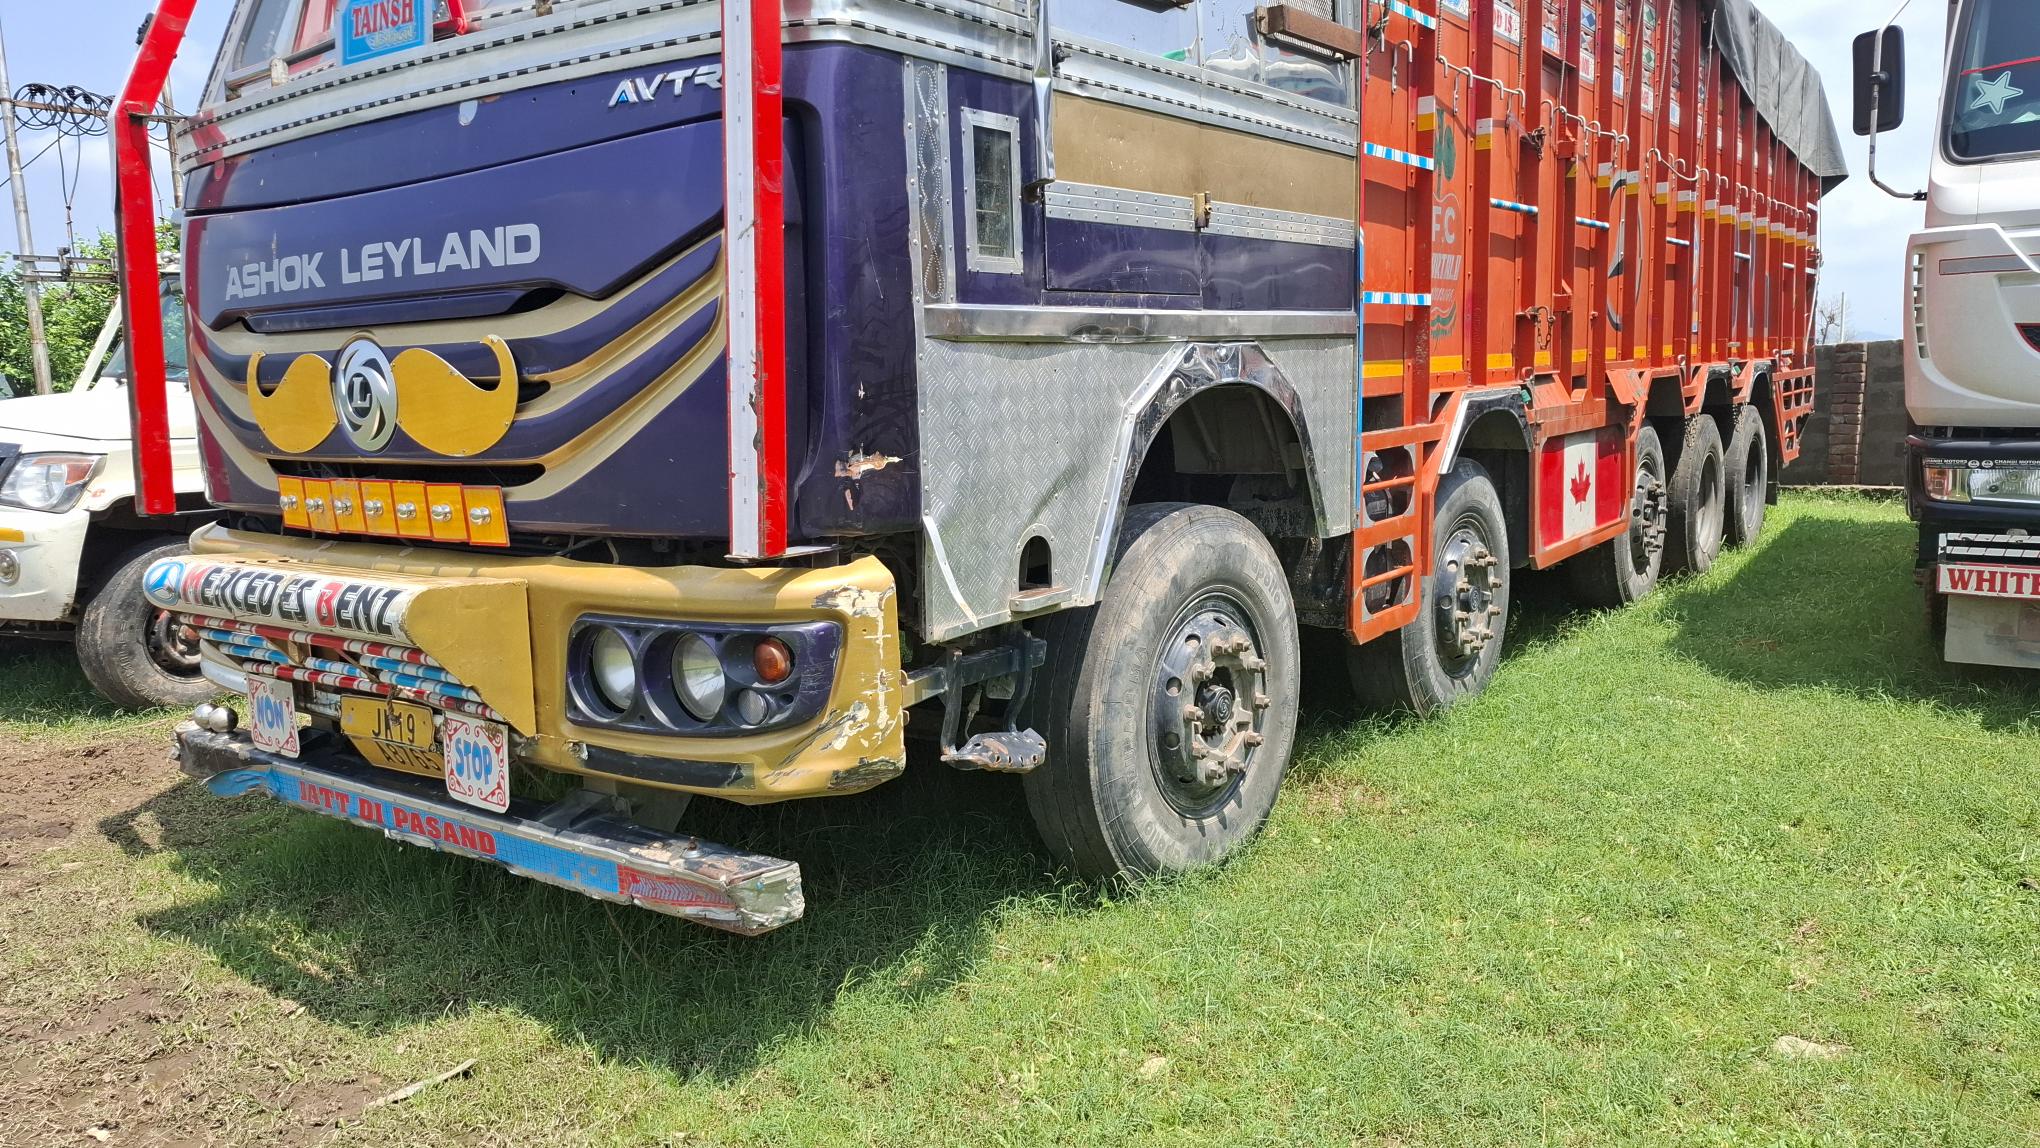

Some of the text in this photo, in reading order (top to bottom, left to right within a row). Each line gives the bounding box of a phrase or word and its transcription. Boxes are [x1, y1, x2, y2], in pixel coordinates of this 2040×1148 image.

[608, 63, 722, 107] AVTR
[225, 223, 541, 300] ASHOK LEYLAND
[315, 581, 405, 639] BENZ
[454, 736, 493, 785] STOP
[358, 798, 384, 825] DI
[392, 806, 496, 855] PASAND
